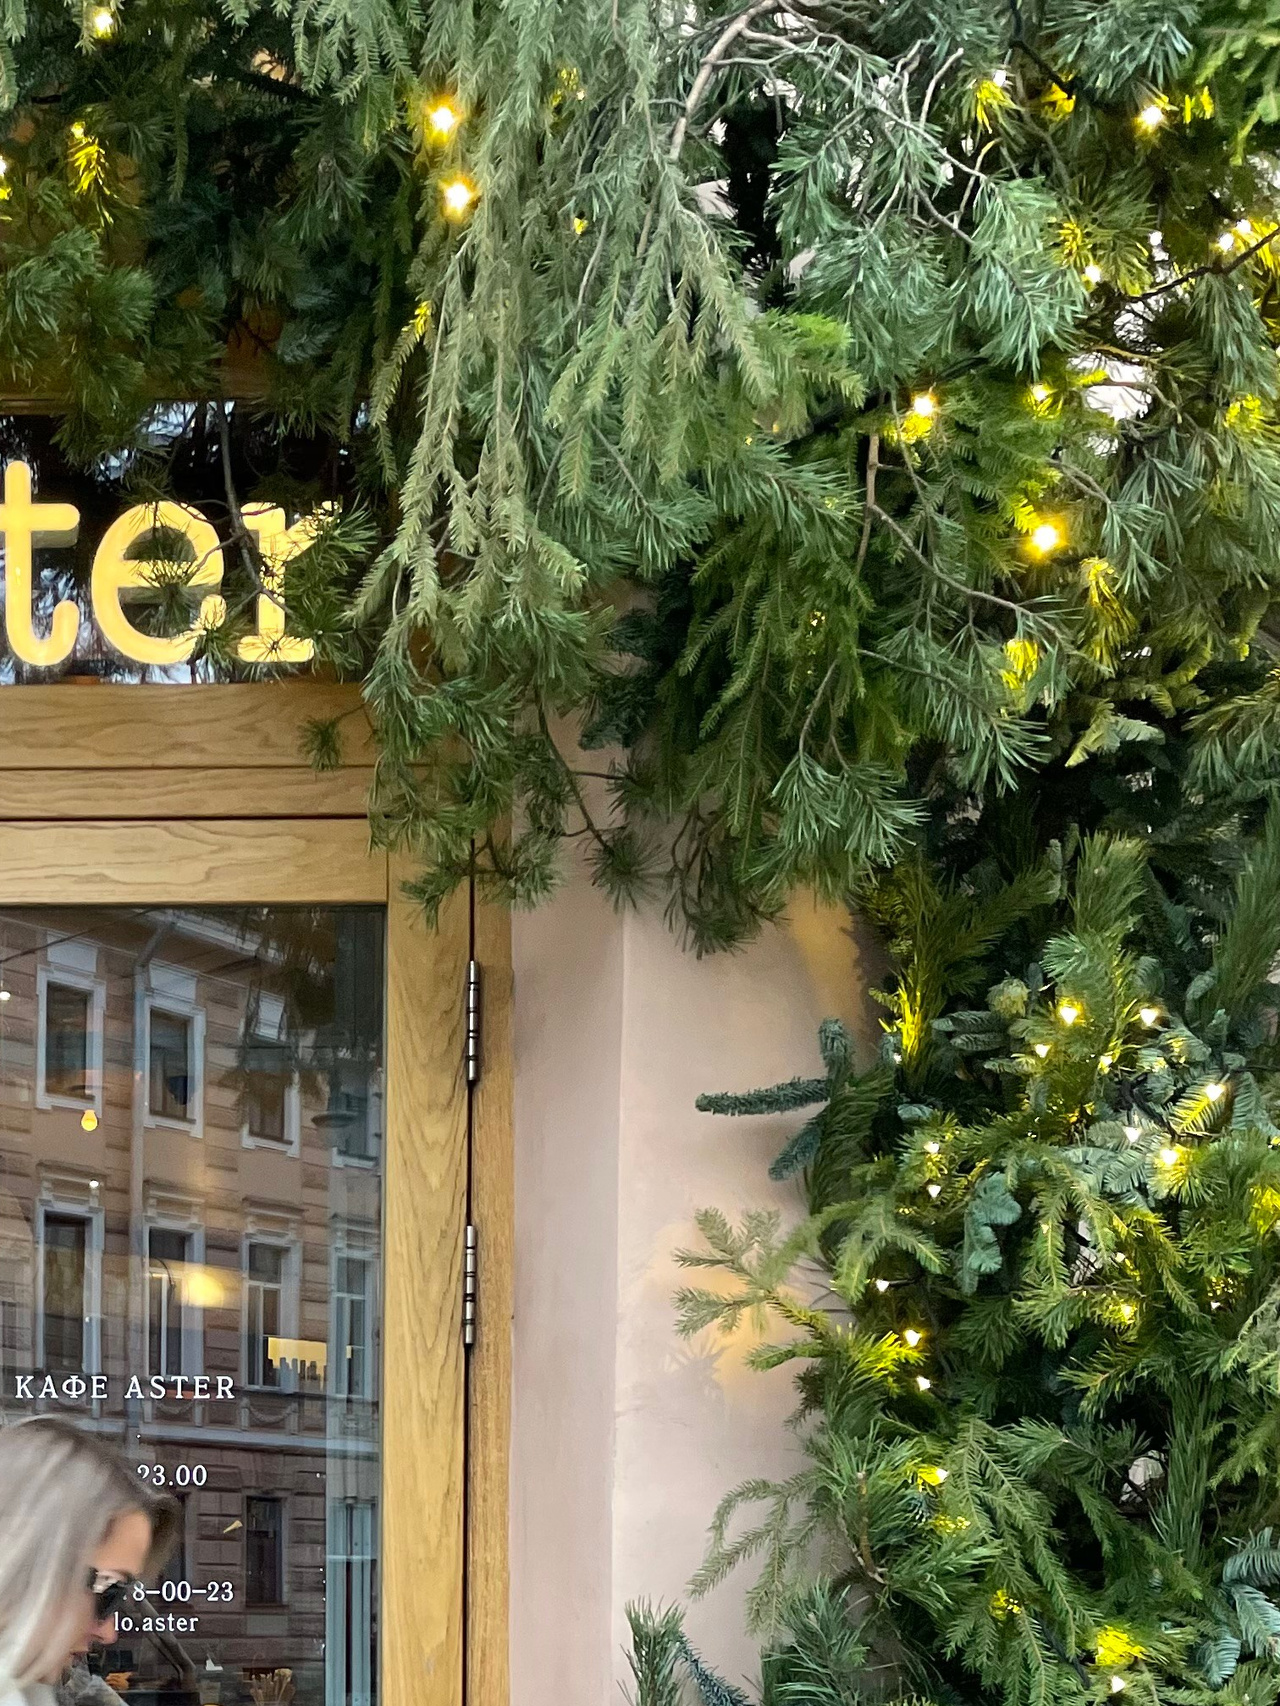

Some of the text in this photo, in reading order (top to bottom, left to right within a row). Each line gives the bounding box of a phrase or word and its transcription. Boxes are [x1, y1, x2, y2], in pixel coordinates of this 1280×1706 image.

[14, 1375, 235, 1399] КАФЕ ASTER
[122, 1581, 234, 1602] 8-00-23
